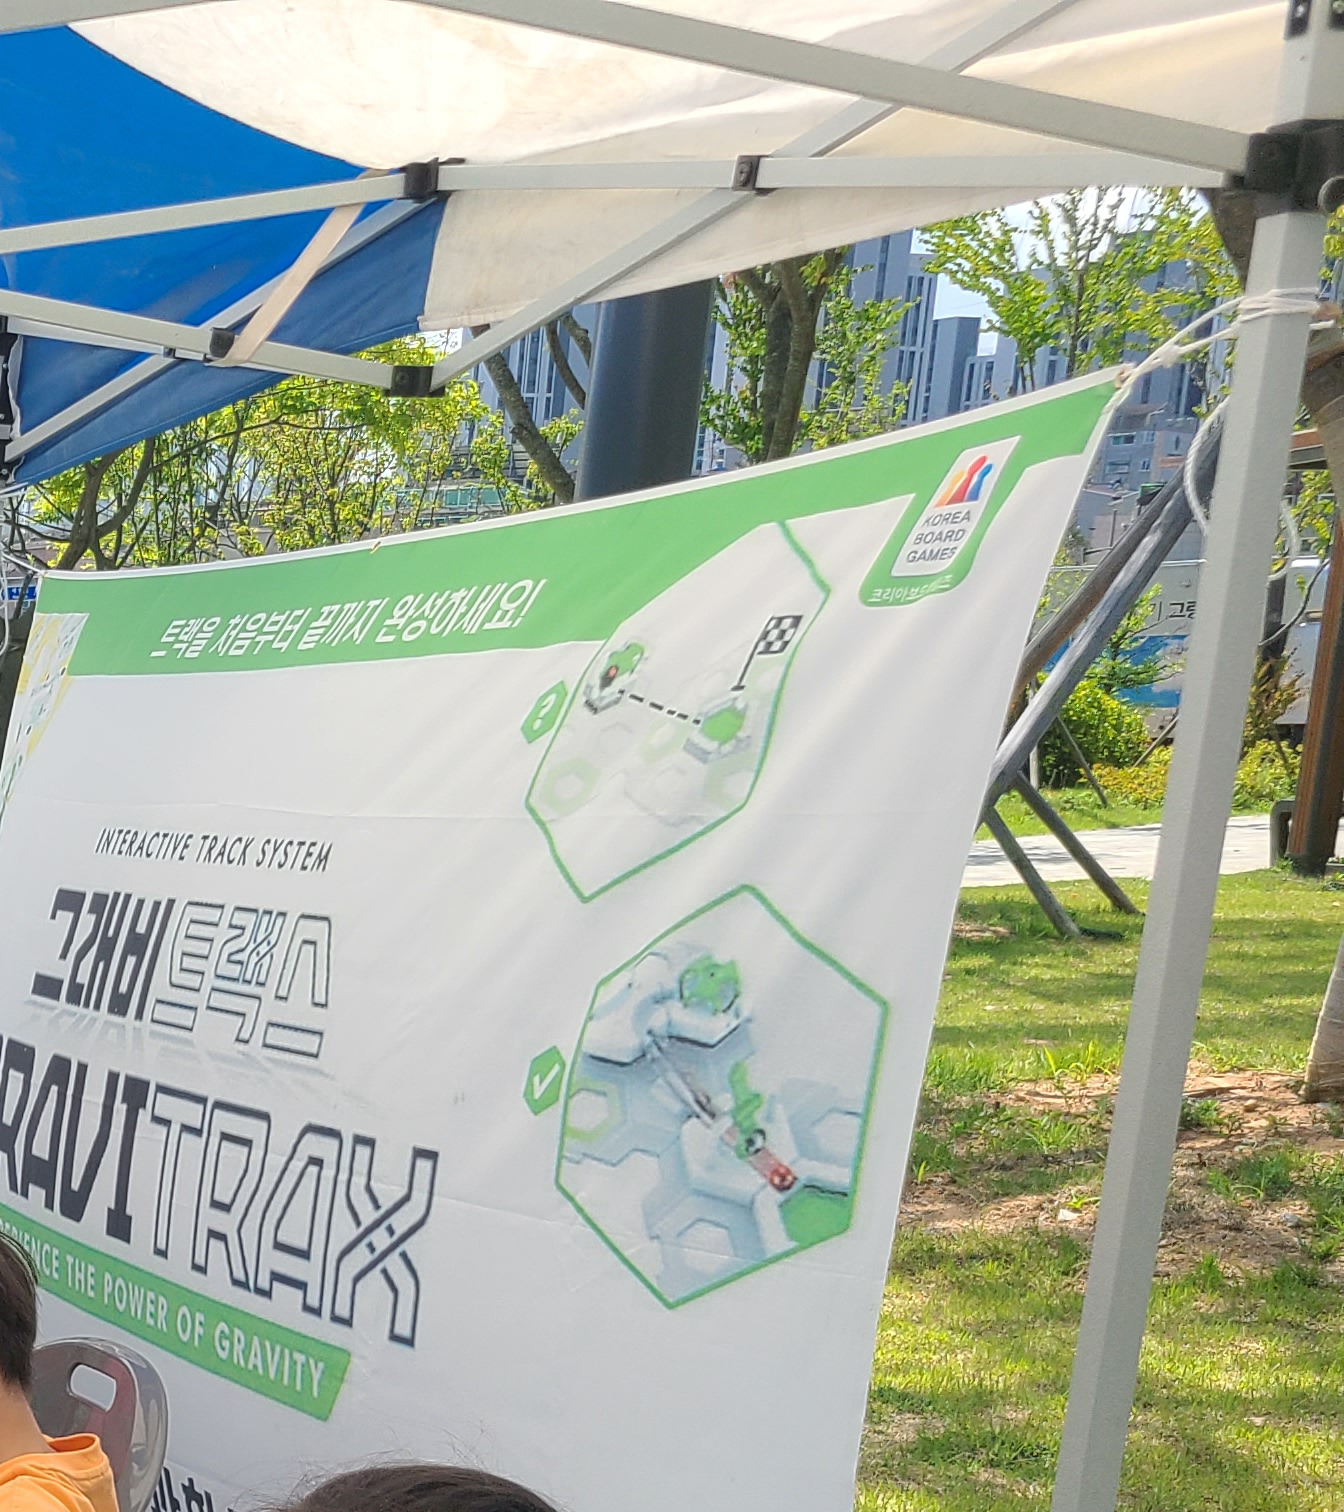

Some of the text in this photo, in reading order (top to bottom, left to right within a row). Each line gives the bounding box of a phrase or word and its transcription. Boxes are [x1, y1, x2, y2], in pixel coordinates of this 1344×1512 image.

[913, 528, 966, 546] BOARD
[921, 509, 972, 529] KOREA
[905, 546, 957, 564] GAMES
[149, 578, 548, 660] 트랙을 처음부터 끝까지 완성하세요!
[95, 827, 333, 873] INTERACTIVE TRACK SYSTEM
[30, 886, 332, 1059] 그래비트랙스
[65, 1253, 97, 1299] THE
[102, 1270, 169, 1334] POWER
[175, 1304, 205, 1348] OF
[214, 1320, 325, 1399] GRAVITY
